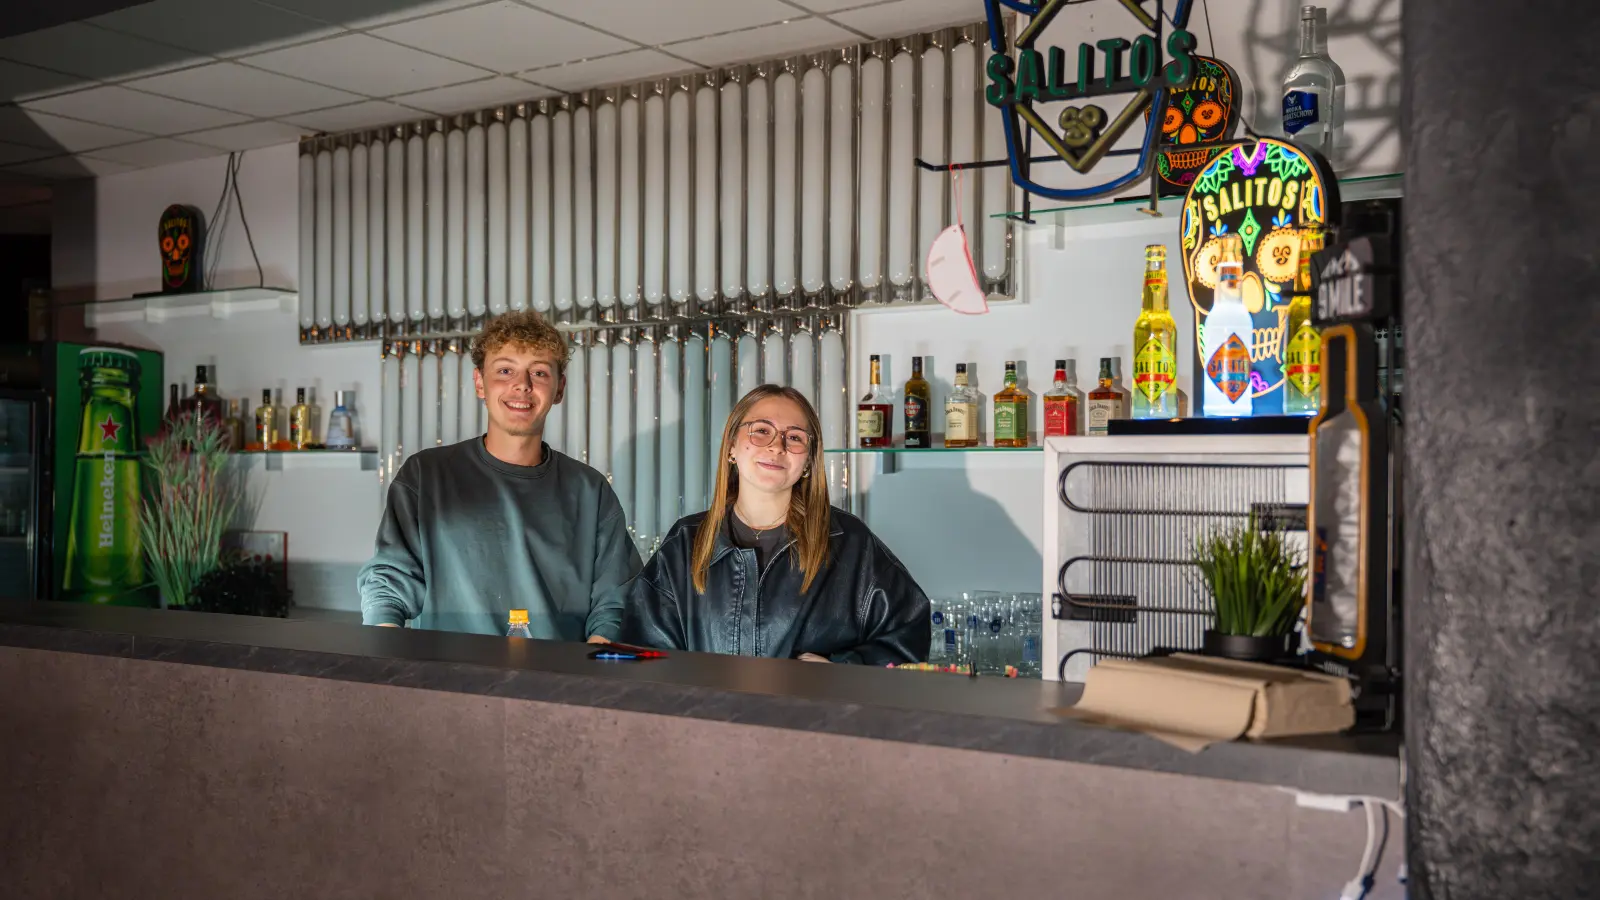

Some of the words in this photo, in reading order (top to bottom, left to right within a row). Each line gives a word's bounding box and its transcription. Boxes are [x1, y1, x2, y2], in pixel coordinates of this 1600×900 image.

[986, 29, 1191, 104] SALITOS
[1203, 177, 1299, 222] SALITOS
[99, 449, 115, 549] Heineken
